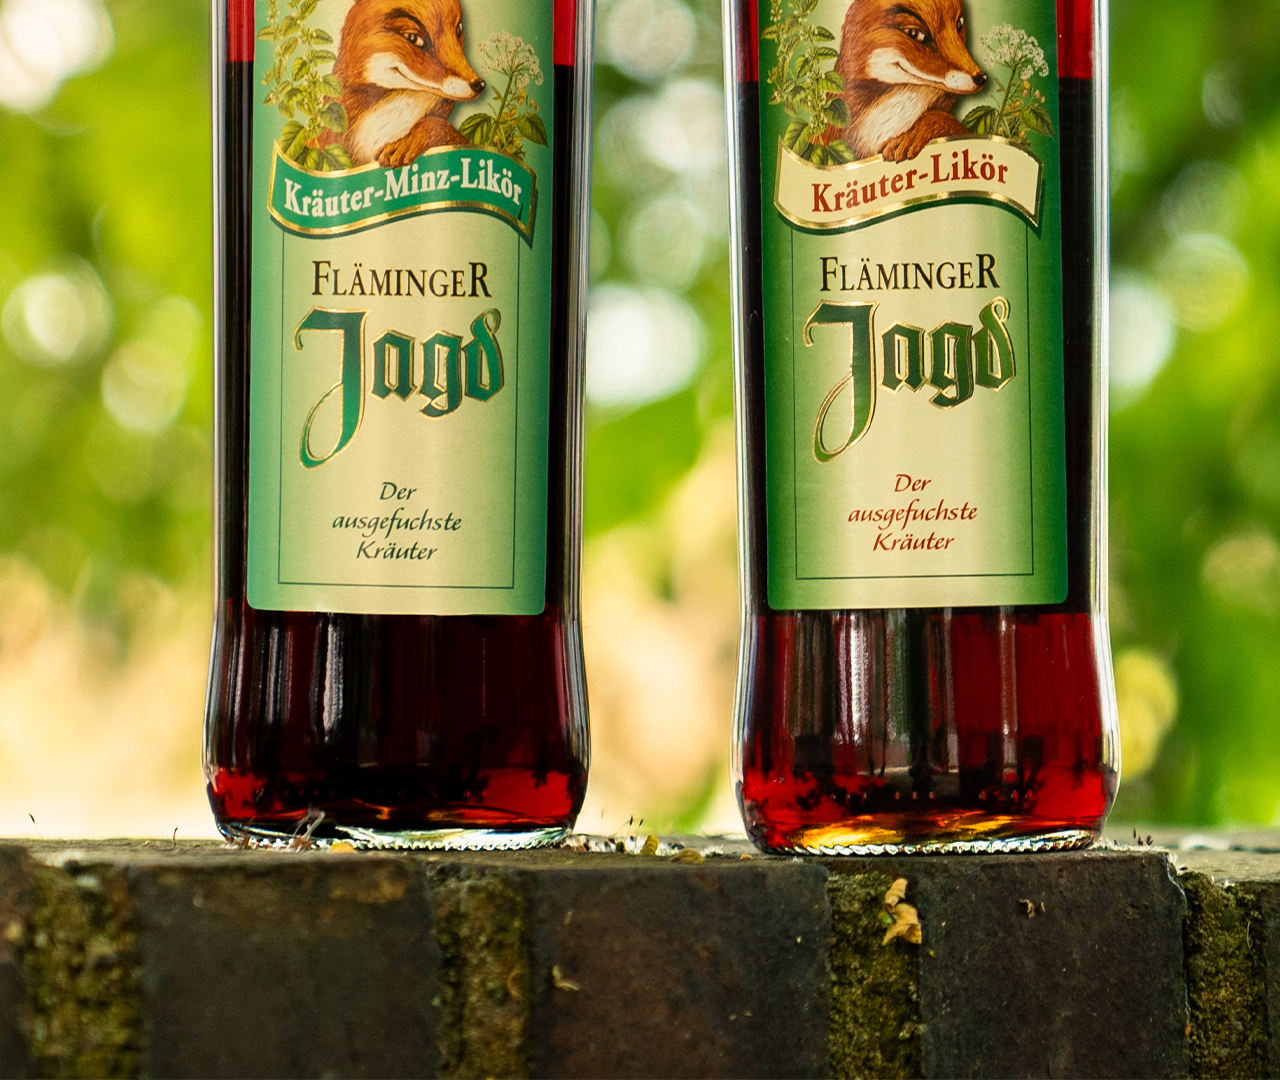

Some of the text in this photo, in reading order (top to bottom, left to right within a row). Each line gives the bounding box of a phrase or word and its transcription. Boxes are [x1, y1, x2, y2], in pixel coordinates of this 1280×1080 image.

[283, 157, 523, 219] Kräuter-Minz-Likör
[811, 149, 1009, 213] Kräuter-Likör
[311, 259, 492, 298] FLÄMINGER
[819, 253, 1001, 293] FLÄMINGER
[292, 306, 505, 469] Jagd
[802, 295, 1017, 464] Jagd
[379, 481, 418, 502] Der
[893, 472, 932, 494] Der
[331, 507, 462, 537] ausgefuchste
[847, 498, 978, 529] ausgefuchste
[355, 539, 438, 562] Kräuter
[872, 530, 955, 553] Kräuter
